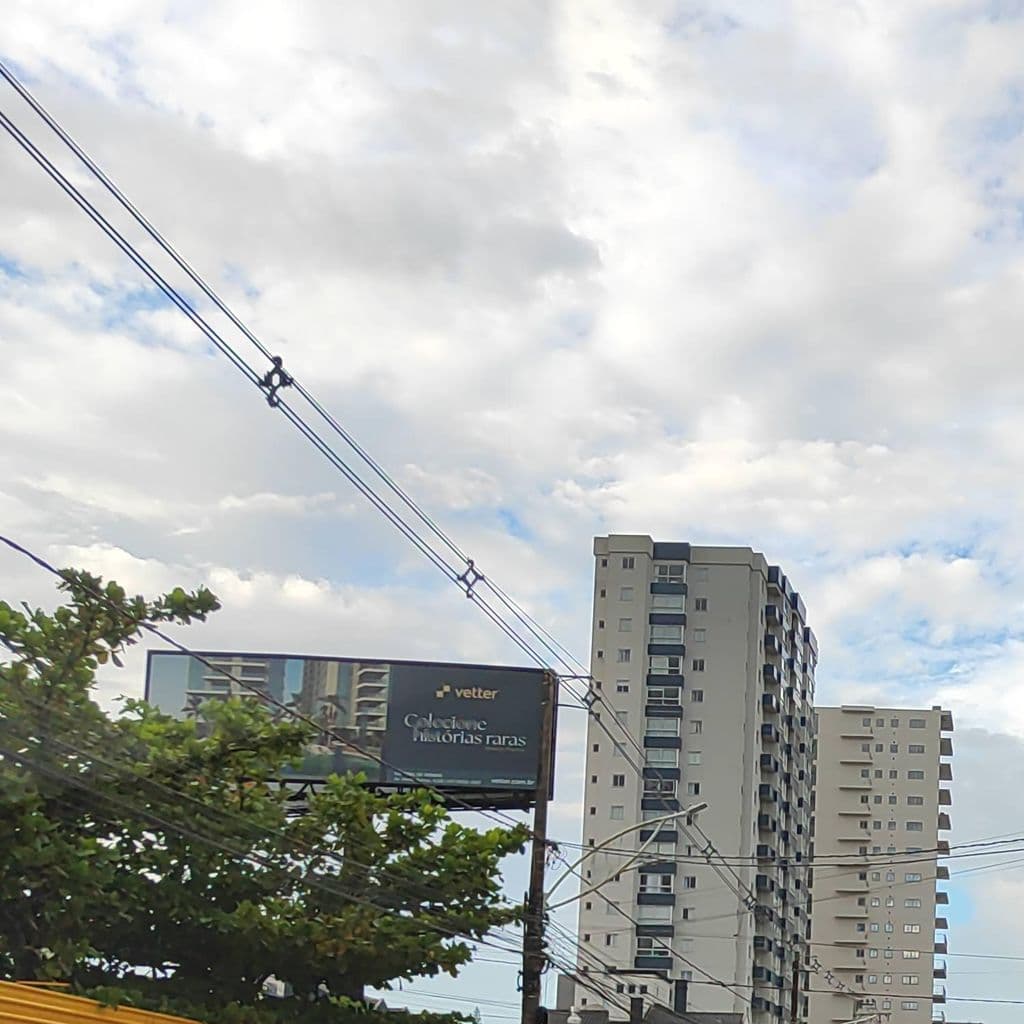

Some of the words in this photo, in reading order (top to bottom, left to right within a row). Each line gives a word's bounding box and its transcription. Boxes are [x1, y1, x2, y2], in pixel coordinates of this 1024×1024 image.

[455, 687, 499, 699] vetter
[404, 713, 488, 731] Colecione
[413, 727, 482, 745] histórias
[485, 735, 527, 747] raras
